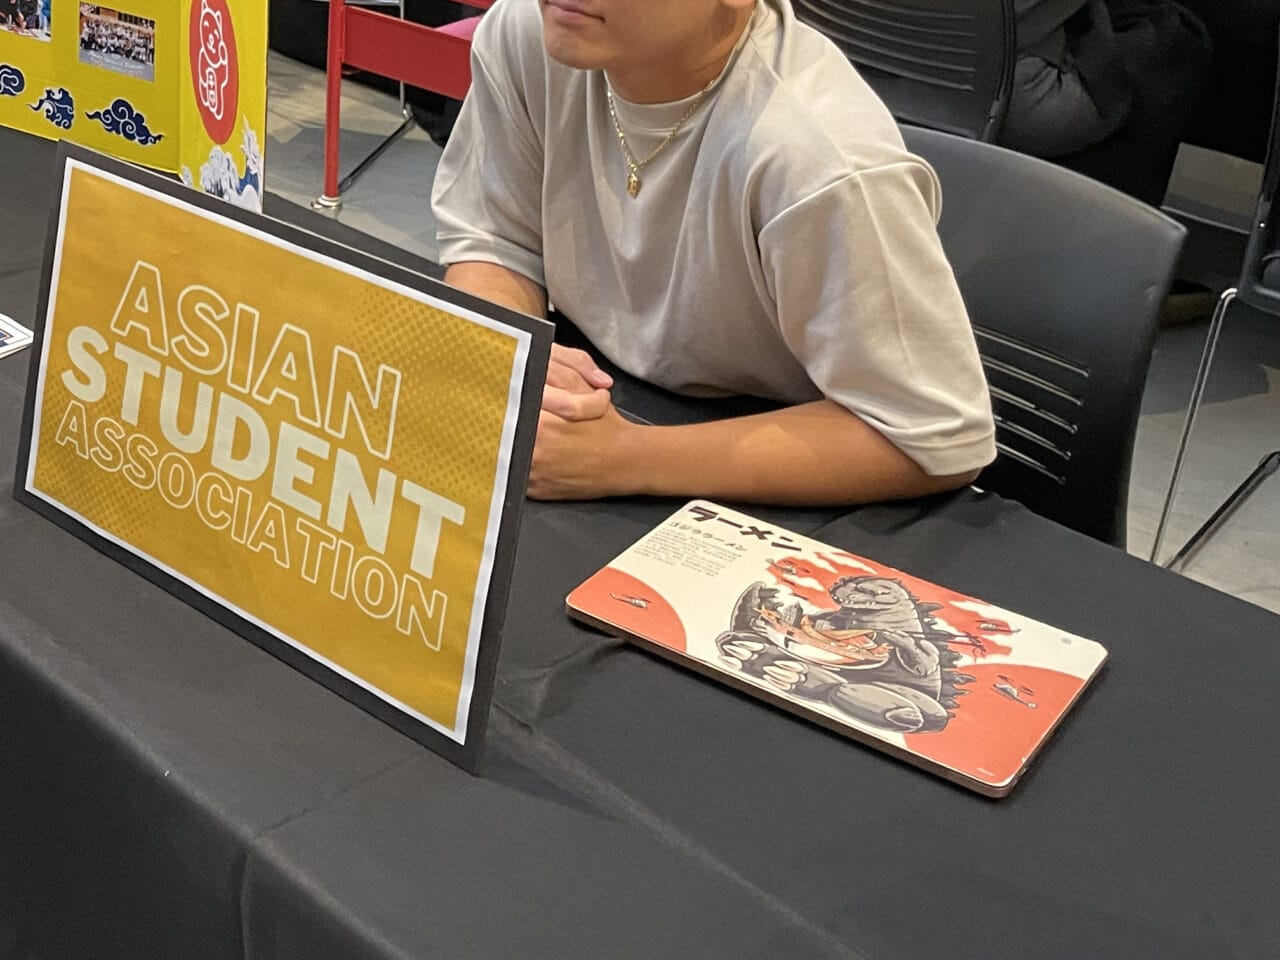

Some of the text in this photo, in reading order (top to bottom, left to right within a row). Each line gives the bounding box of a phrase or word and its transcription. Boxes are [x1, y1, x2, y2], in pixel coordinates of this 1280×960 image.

[60, 325, 466, 580] STUDENT
[110, 260, 402, 460] ASIAN
[54, 401, 448, 653] ASSOCIATION
[688, 506, 803, 552] ラーメン
